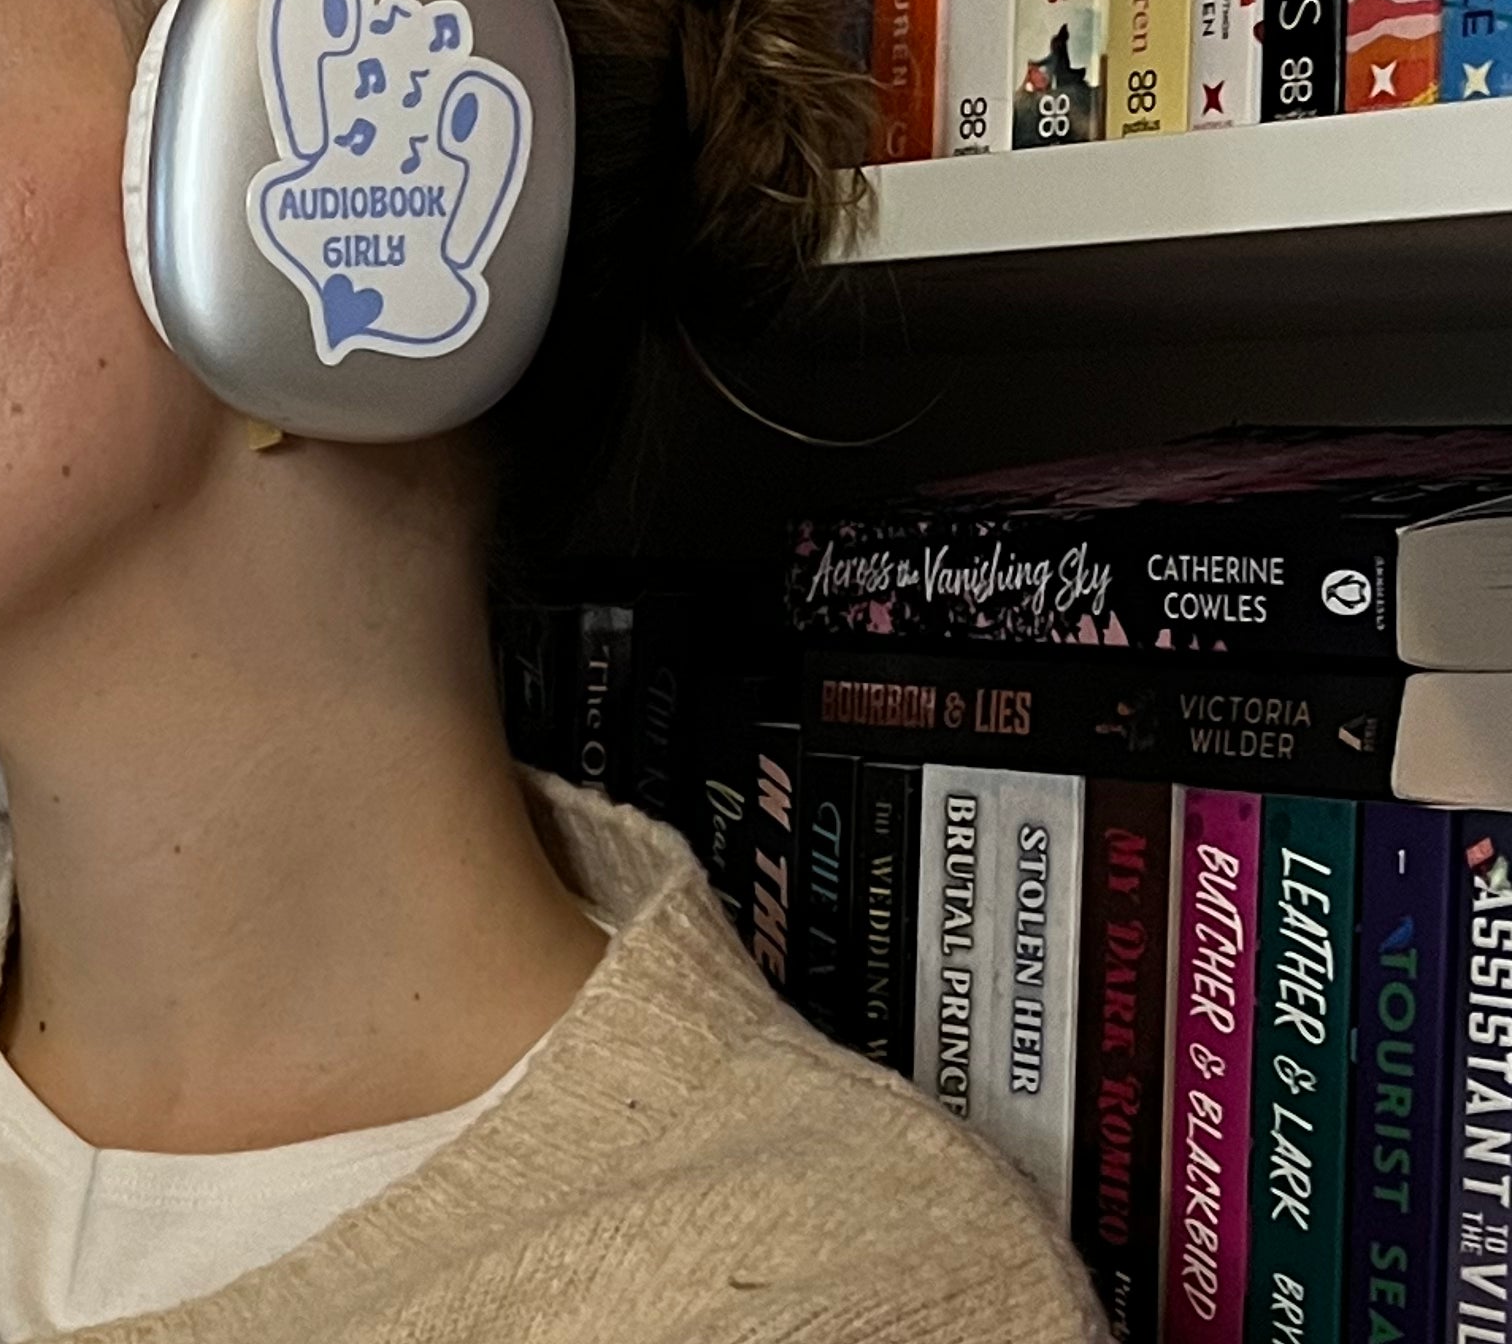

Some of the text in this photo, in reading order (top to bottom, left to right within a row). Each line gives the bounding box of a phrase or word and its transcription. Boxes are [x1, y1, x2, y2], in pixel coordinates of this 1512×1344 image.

[278, 184, 447, 222] AUDIOBOOK
[322, 234, 406, 269] GIRLY
[805, 539, 1114, 617] Across the Vanishing Sky
[1146, 554, 1286, 587] CATHERINE
[1162, 591, 1268, 624] COWLES
[820, 678, 1033, 737] BOURBON LIES
[1179, 694, 1313, 730] VICTORIA
[1189, 729, 1296, 761] WILDER
[755, 752, 793, 833] IN
[865, 854, 895, 1022] WEDDING
[934, 792, 978, 1122] BRUTAL PRINCE
[1009, 822, 1051, 1096] STOLEN HEIR
[1188, 842, 1244, 1037] BUTCHER
[1273, 846, 1337, 1047] LEATHER
[1188, 1041, 1228, 1082] &
[1272, 1053, 1319, 1096] &
[1372, 946, 1420, 1215] TOURIST
[1461, 873, 1512, 1210] ASSISTANT
[1098, 919, 1148, 1248] DARK ROMEO
[1182, 1087, 1224, 1323] BLACKBIRD
[1268, 1102, 1315, 1232] LARK
[1459, 1210, 1485, 1256] THE
[1484, 1222, 1509, 1255] TO
